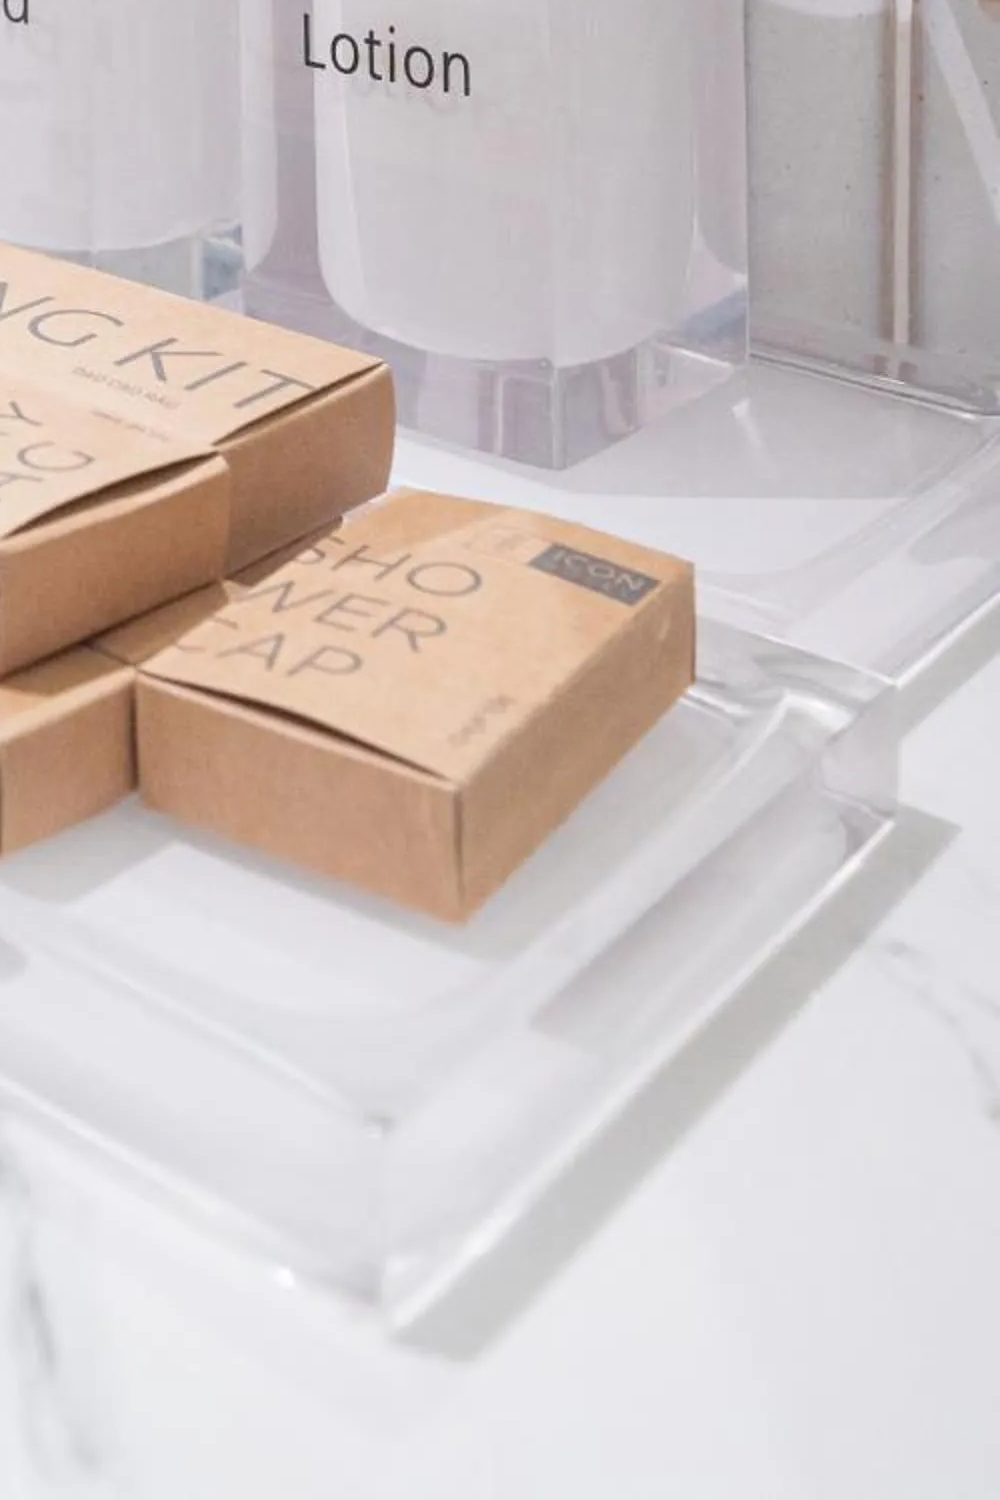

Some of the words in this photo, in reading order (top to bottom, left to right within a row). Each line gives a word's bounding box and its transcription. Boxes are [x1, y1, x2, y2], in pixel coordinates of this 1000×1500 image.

[302, 12, 472, 97] Lotion
[113, 337, 317, 409] KIT
[296, 535, 483, 597] SHO
[551, 548, 647, 591] ICON
